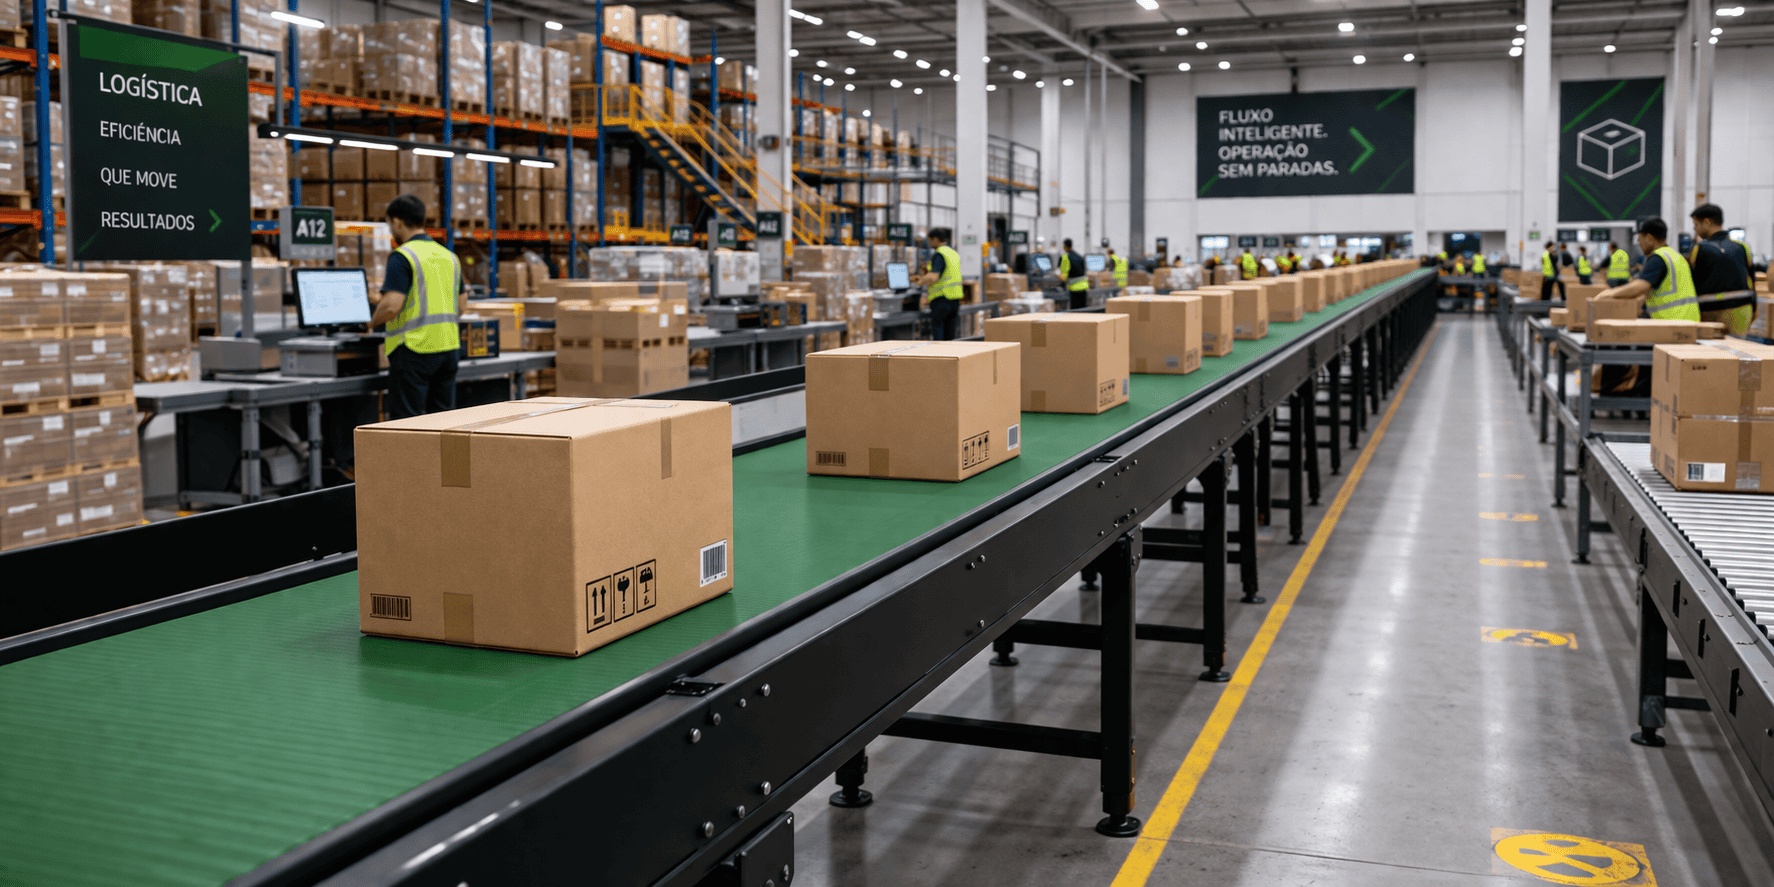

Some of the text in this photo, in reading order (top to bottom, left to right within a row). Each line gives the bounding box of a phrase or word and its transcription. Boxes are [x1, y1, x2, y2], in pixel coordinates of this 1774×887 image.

[100, 72, 203, 107] LOGÍSTICA
[1219, 108, 1274, 124] FLUXO
[1218, 123, 1328, 141] INTELIGENTE.
[1218, 141, 1309, 161] OPERAÇÃO
[100, 167, 178, 189] QUE MOVE
[1218, 160, 1339, 179] SEM PARADAS.
[101, 211, 195, 231] RESULTADOS
[296, 218, 327, 238] A12
